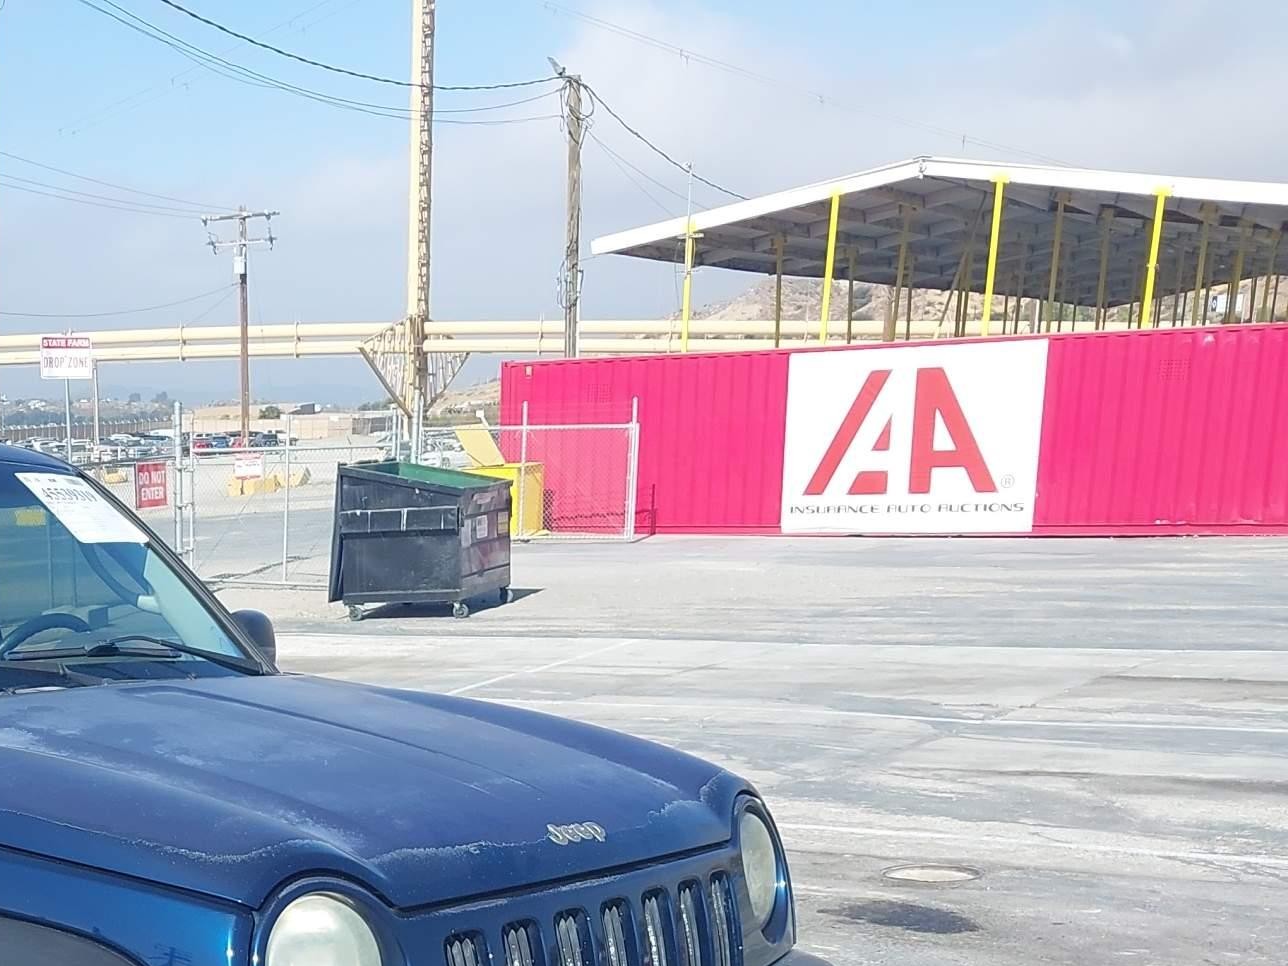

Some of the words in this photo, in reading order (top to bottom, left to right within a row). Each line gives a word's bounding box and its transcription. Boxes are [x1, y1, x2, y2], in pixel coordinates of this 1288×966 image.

[43, 338, 66, 348] STATE
[43, 356, 64, 368] DROP
[67, 356, 89, 368] ZONE
[139, 471, 149, 484] DO
[151, 470, 165, 484] NOT
[141, 487, 164, 500] ENTER
[790, 503, 880, 515] INSURANCE
[886, 503, 931, 514] AUTO
[937, 502, 1025, 513] AUCTIONS
[546, 821, 606, 846] Jeep
